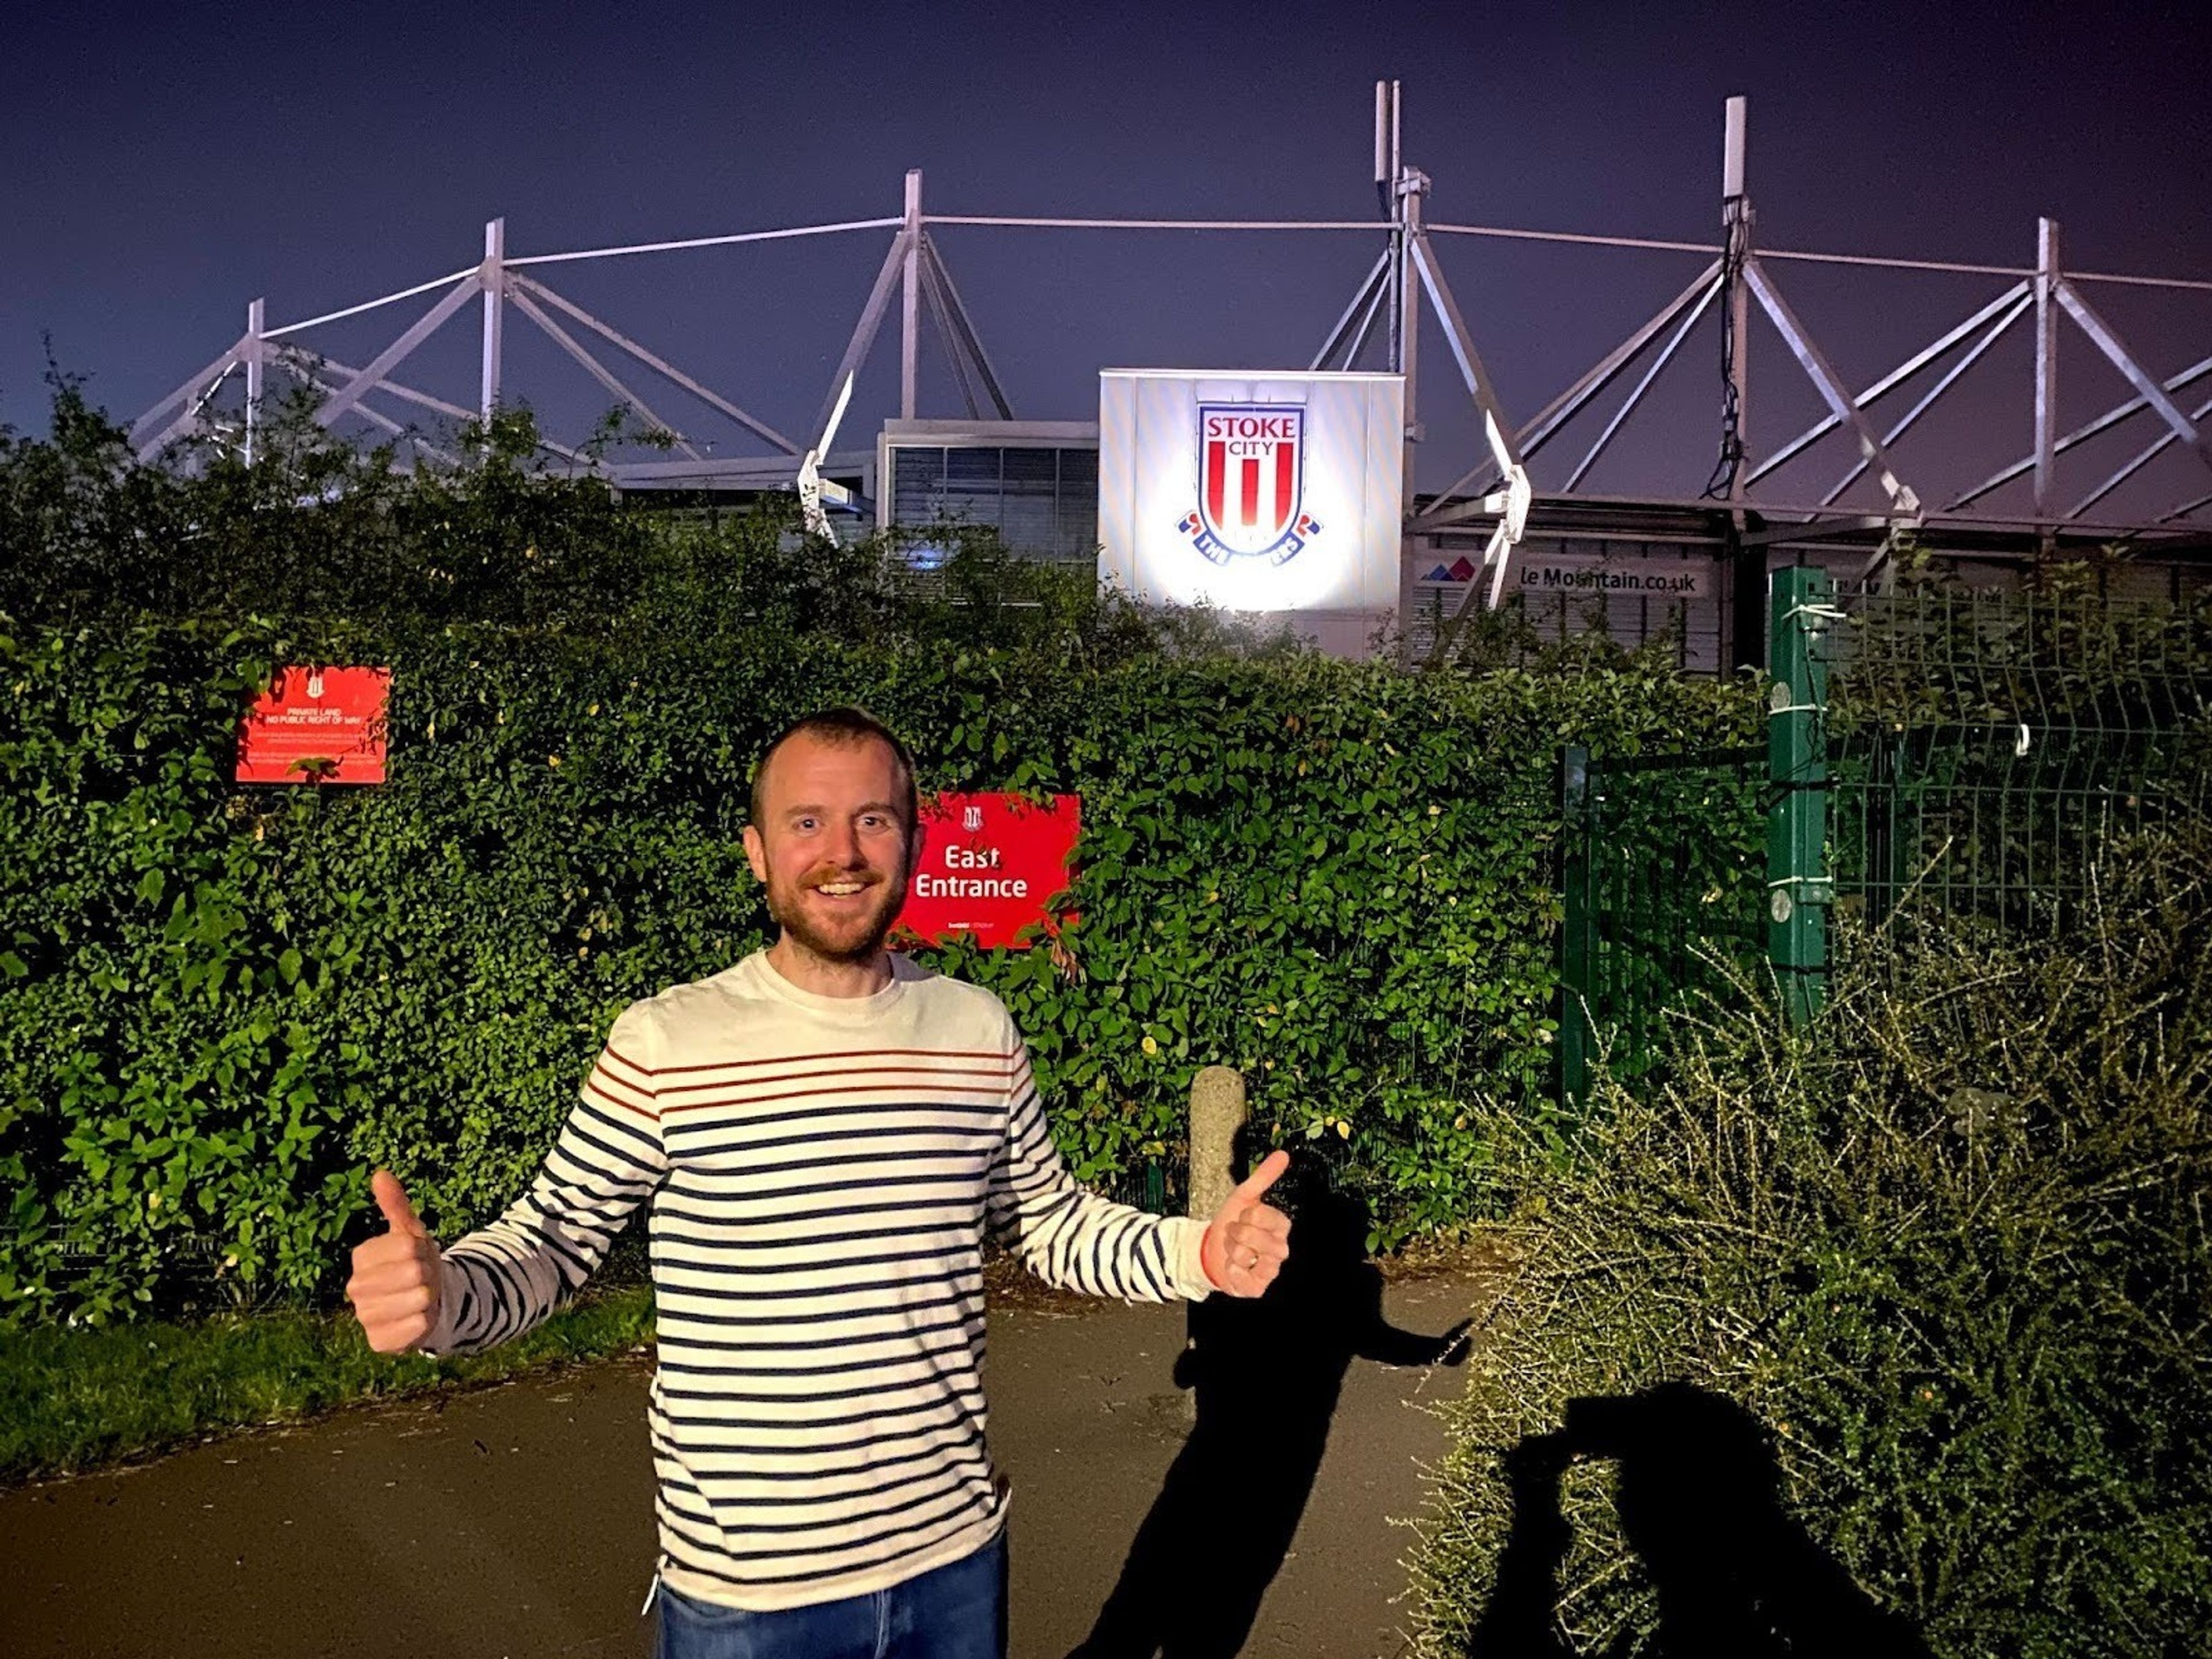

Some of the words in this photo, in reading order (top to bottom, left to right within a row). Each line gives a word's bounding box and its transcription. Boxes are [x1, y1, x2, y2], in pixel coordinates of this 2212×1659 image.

[1208, 417, 1296, 438] STOKE
[1229, 441, 1272, 456] CITY
[266, 715, 278, 724] NO
[280, 716, 305, 724] PUBLIC
[308, 716, 330, 725] RIGHT
[287, 707, 317, 716] PRIVATE
[320, 708, 342, 716] LAND
[945, 844, 999, 868] East
[916, 874, 1027, 897] Entrance
